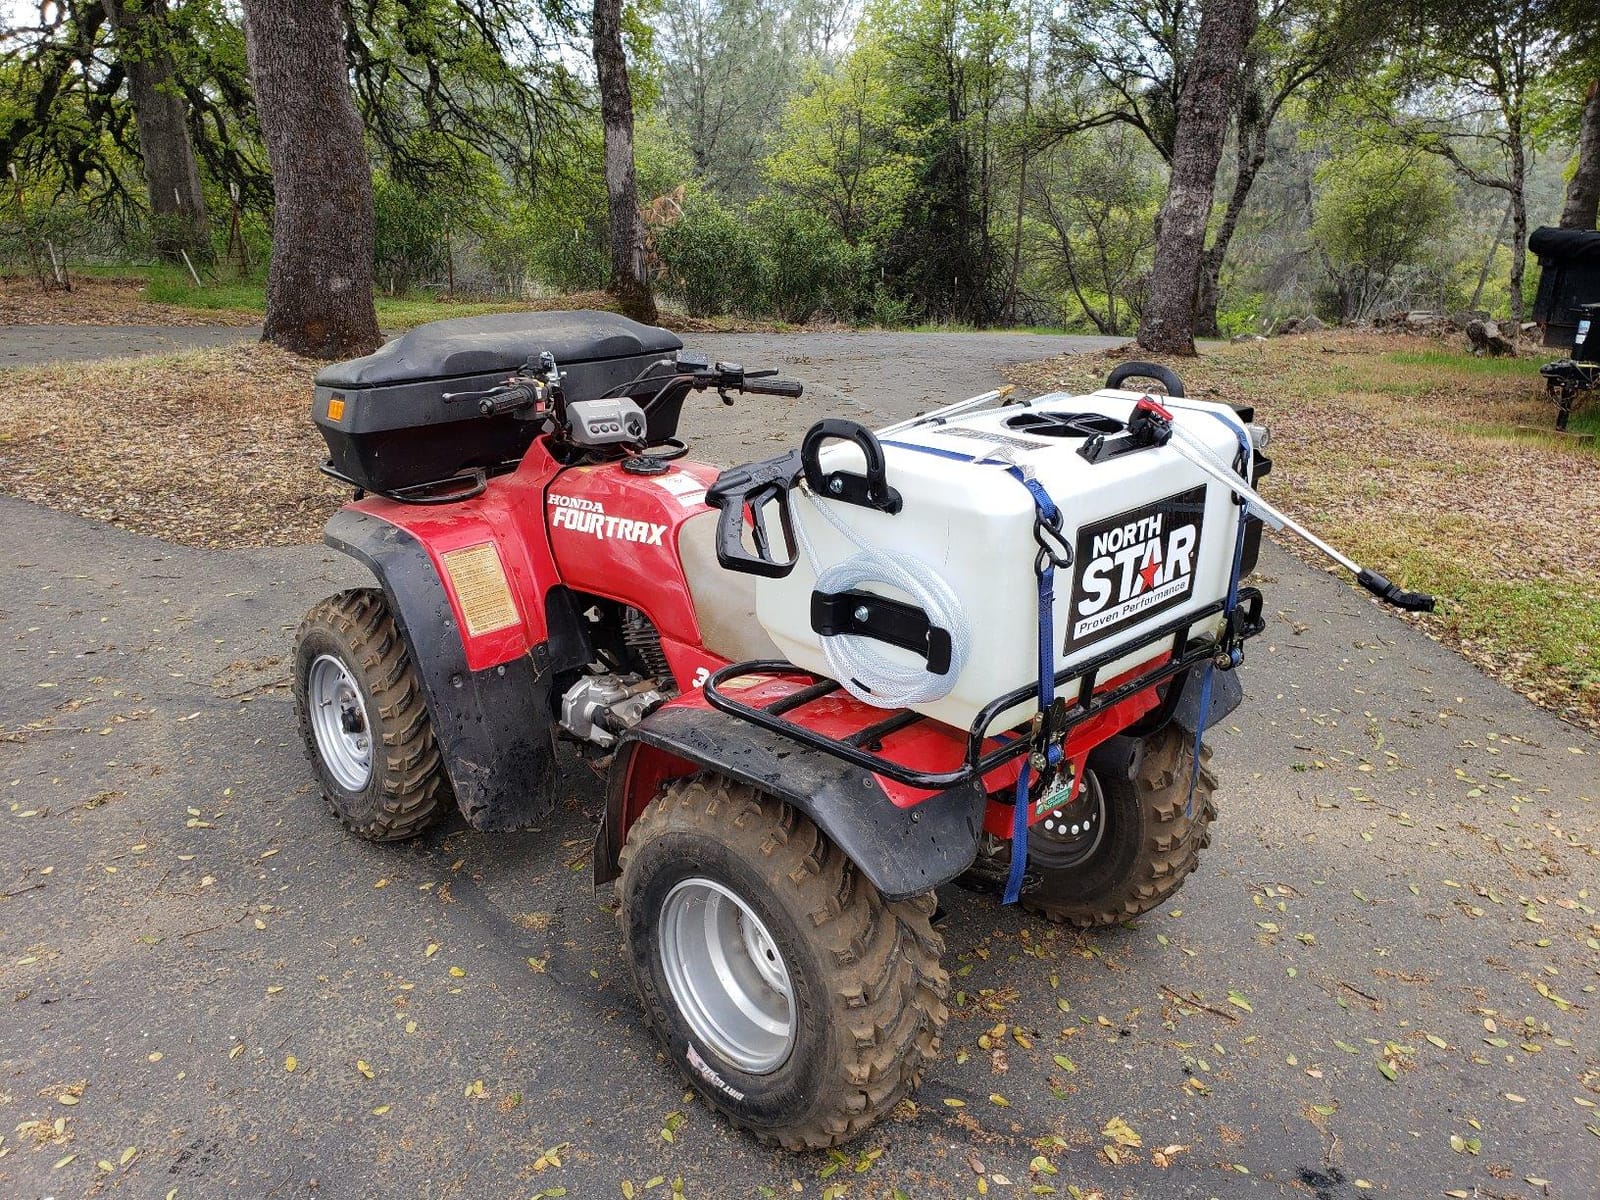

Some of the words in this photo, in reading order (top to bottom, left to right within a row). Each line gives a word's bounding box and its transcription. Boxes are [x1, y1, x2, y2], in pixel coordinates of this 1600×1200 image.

[547, 494, 604, 514] HONDA
[552, 506, 668, 547] FOURTRAX
[1092, 513, 1163, 559] NORTH
[1078, 523, 1197, 617] STAR
[1079, 610, 1119, 635] Proven
[1122, 580, 1186, 616] Performance
